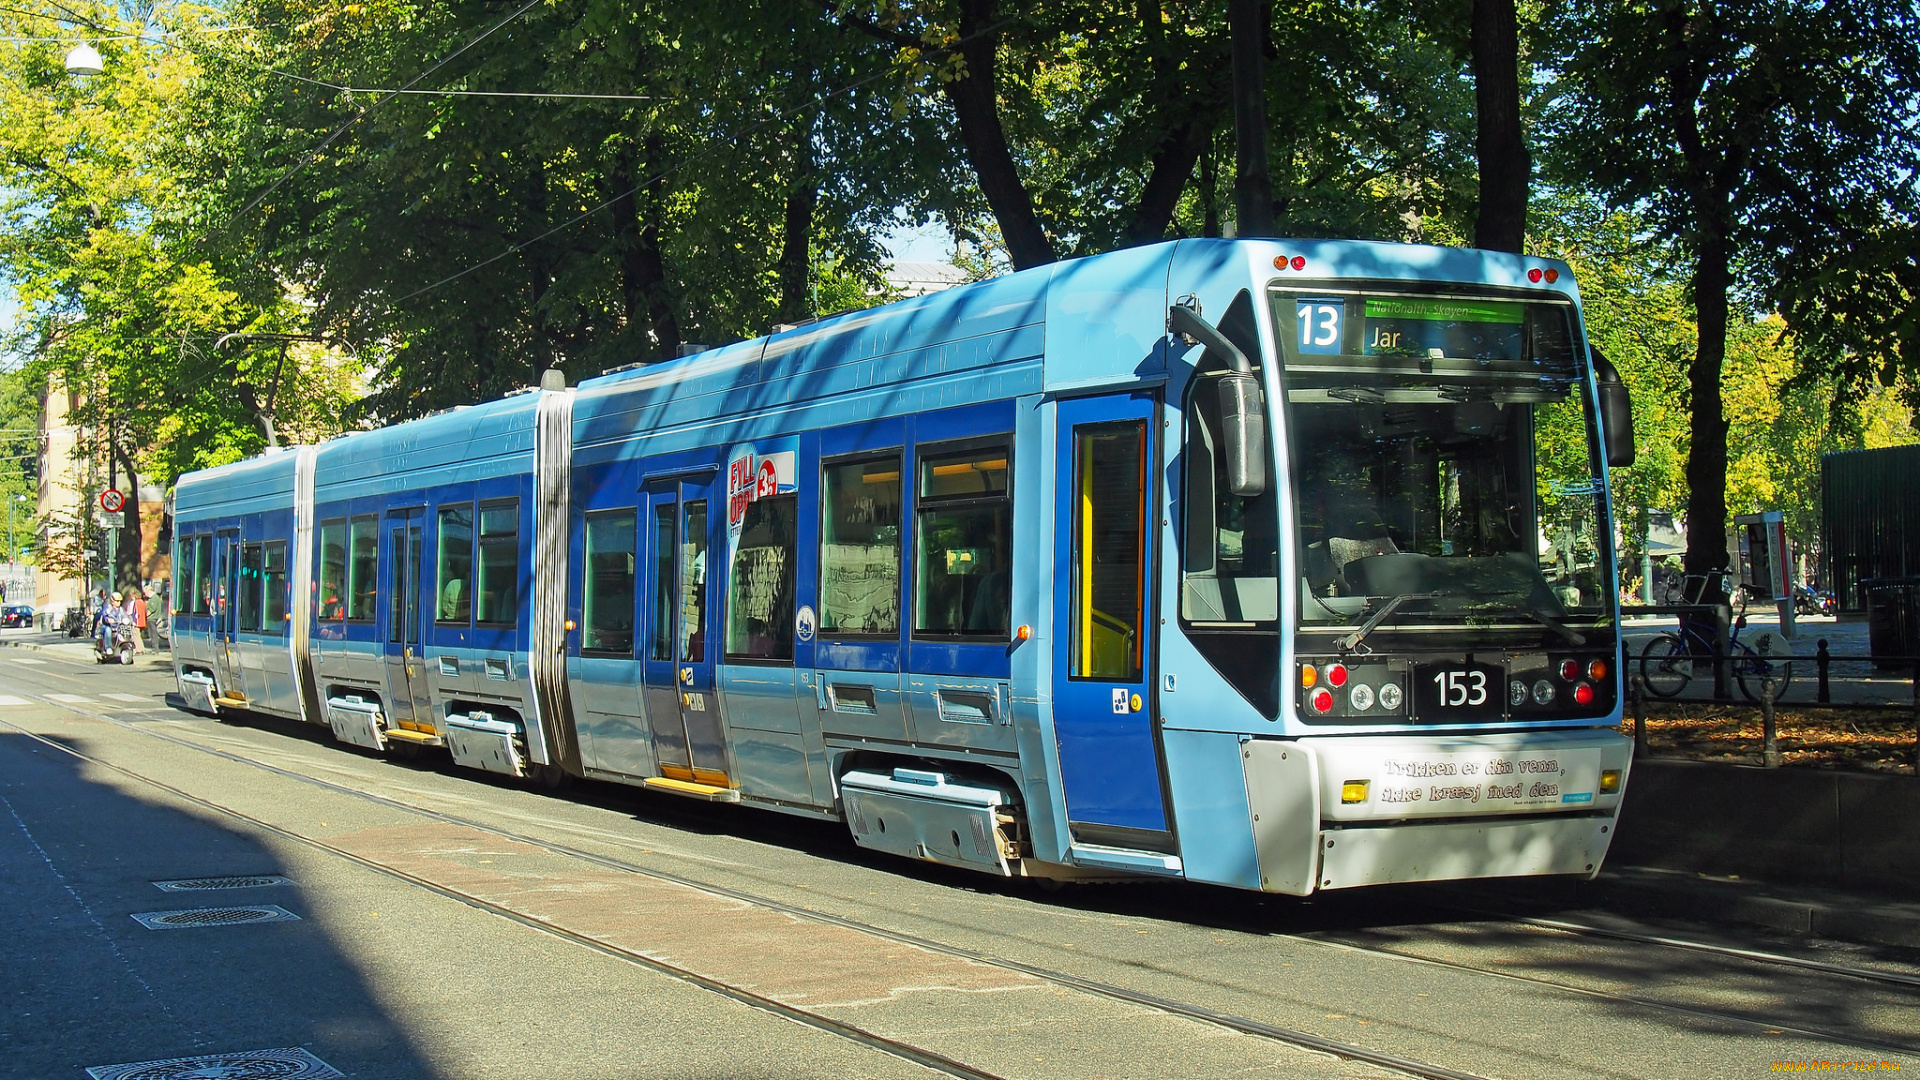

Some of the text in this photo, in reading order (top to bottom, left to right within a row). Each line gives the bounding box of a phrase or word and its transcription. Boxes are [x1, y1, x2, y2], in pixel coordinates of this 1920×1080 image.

[1297, 305, 1339, 346] 13
[1371, 327, 1401, 348] Jar
[730, 453, 756, 494] FYLL
[801, 672, 809, 683] 153
[1434, 670, 1487, 707] 153
[1384, 759, 1457, 777] Trikken
[1462, 761, 1481, 775] er
[1485, 759, 1513, 775] din
[1382, 781, 1558, 803] ikke kræsj med den
